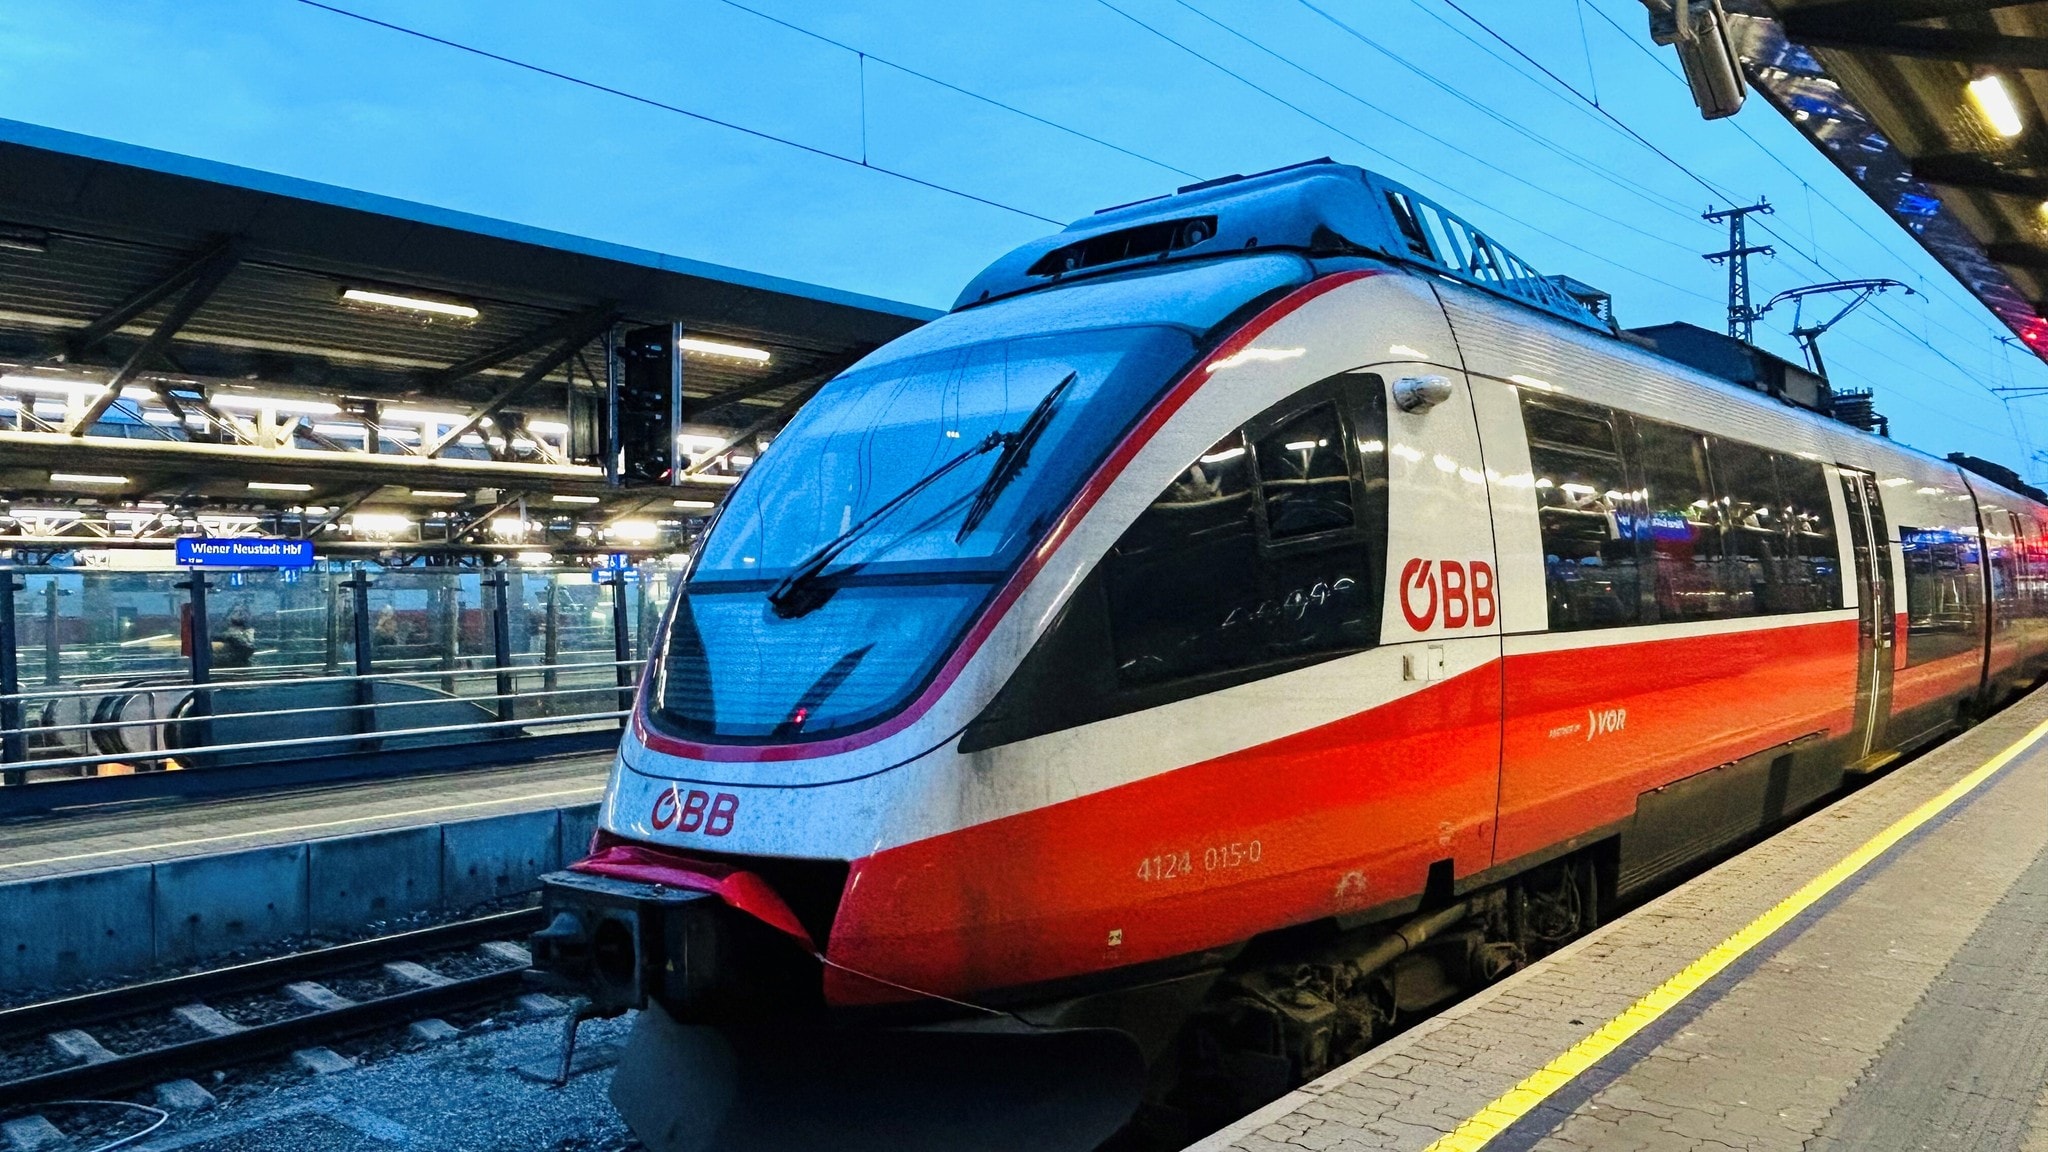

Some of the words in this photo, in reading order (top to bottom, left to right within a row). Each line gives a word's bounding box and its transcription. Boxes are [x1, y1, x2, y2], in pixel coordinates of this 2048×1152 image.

[191, 543, 231, 554] Wiener
[233, 543, 280, 555] Neustadt
[283, 544, 302, 555] Hbf
[1400, 558, 1496, 632] ÖBB
[1598, 708, 1627, 736] VOR
[651, 787, 740, 837] ÖBB
[1137, 850, 1192, 881] 4124
